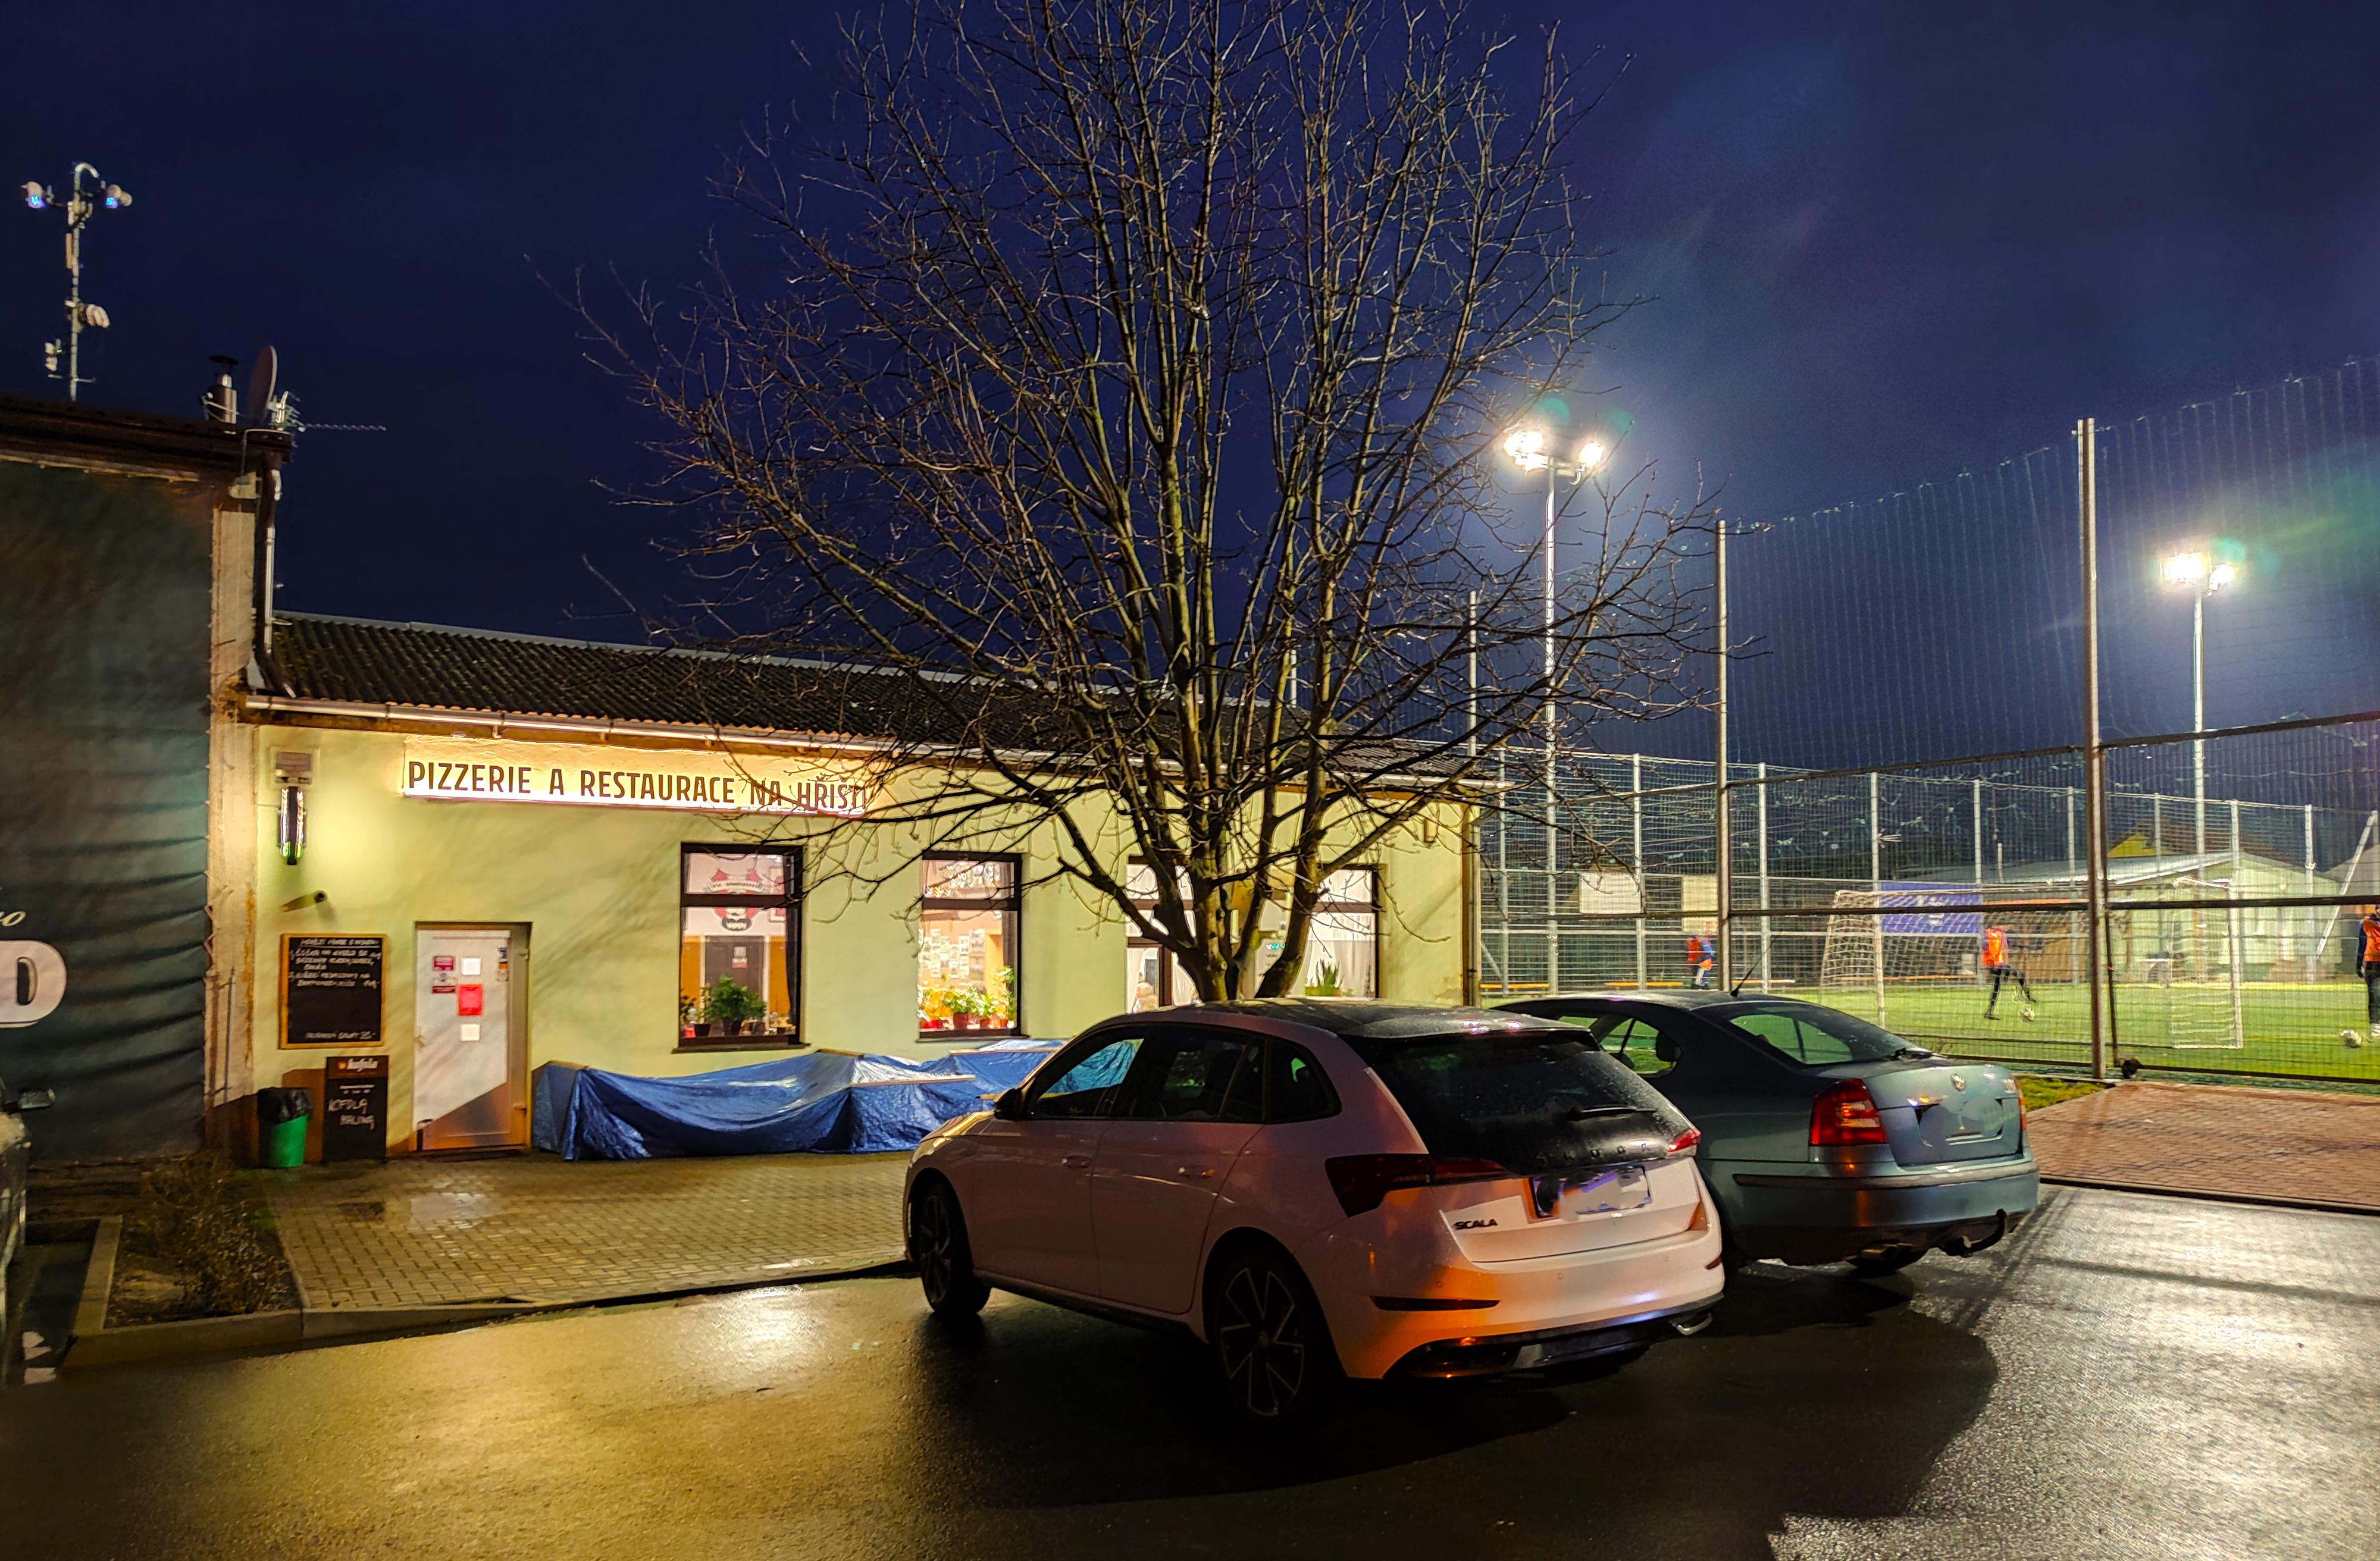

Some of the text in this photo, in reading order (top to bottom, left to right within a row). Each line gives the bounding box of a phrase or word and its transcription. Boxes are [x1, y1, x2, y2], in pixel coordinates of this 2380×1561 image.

[409, 761, 531, 794] PIZZERIE
[549, 769, 564, 795] A
[580, 770, 735, 803] RESTAURACE
[750, 780, 782, 806] NA
[1454, 1219, 1498, 1230] SCALA
